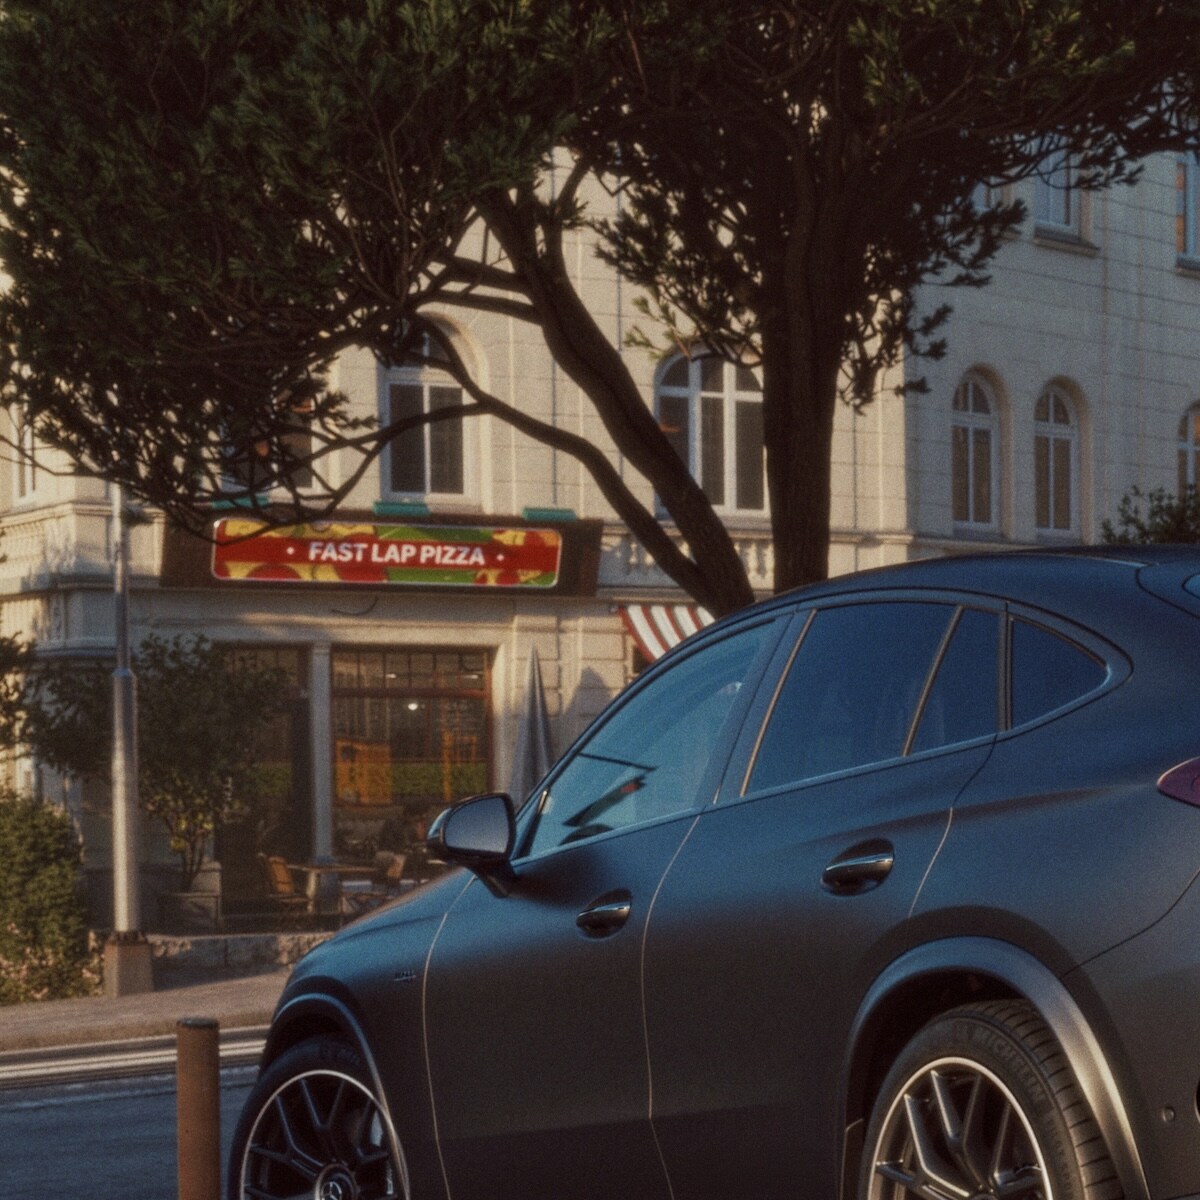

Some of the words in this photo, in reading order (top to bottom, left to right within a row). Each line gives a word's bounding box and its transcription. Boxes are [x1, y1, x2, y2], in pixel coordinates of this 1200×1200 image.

[308, 541, 367, 562] FAST
[371, 544, 418, 564] LAP
[420, 545, 486, 566] PIZZA
